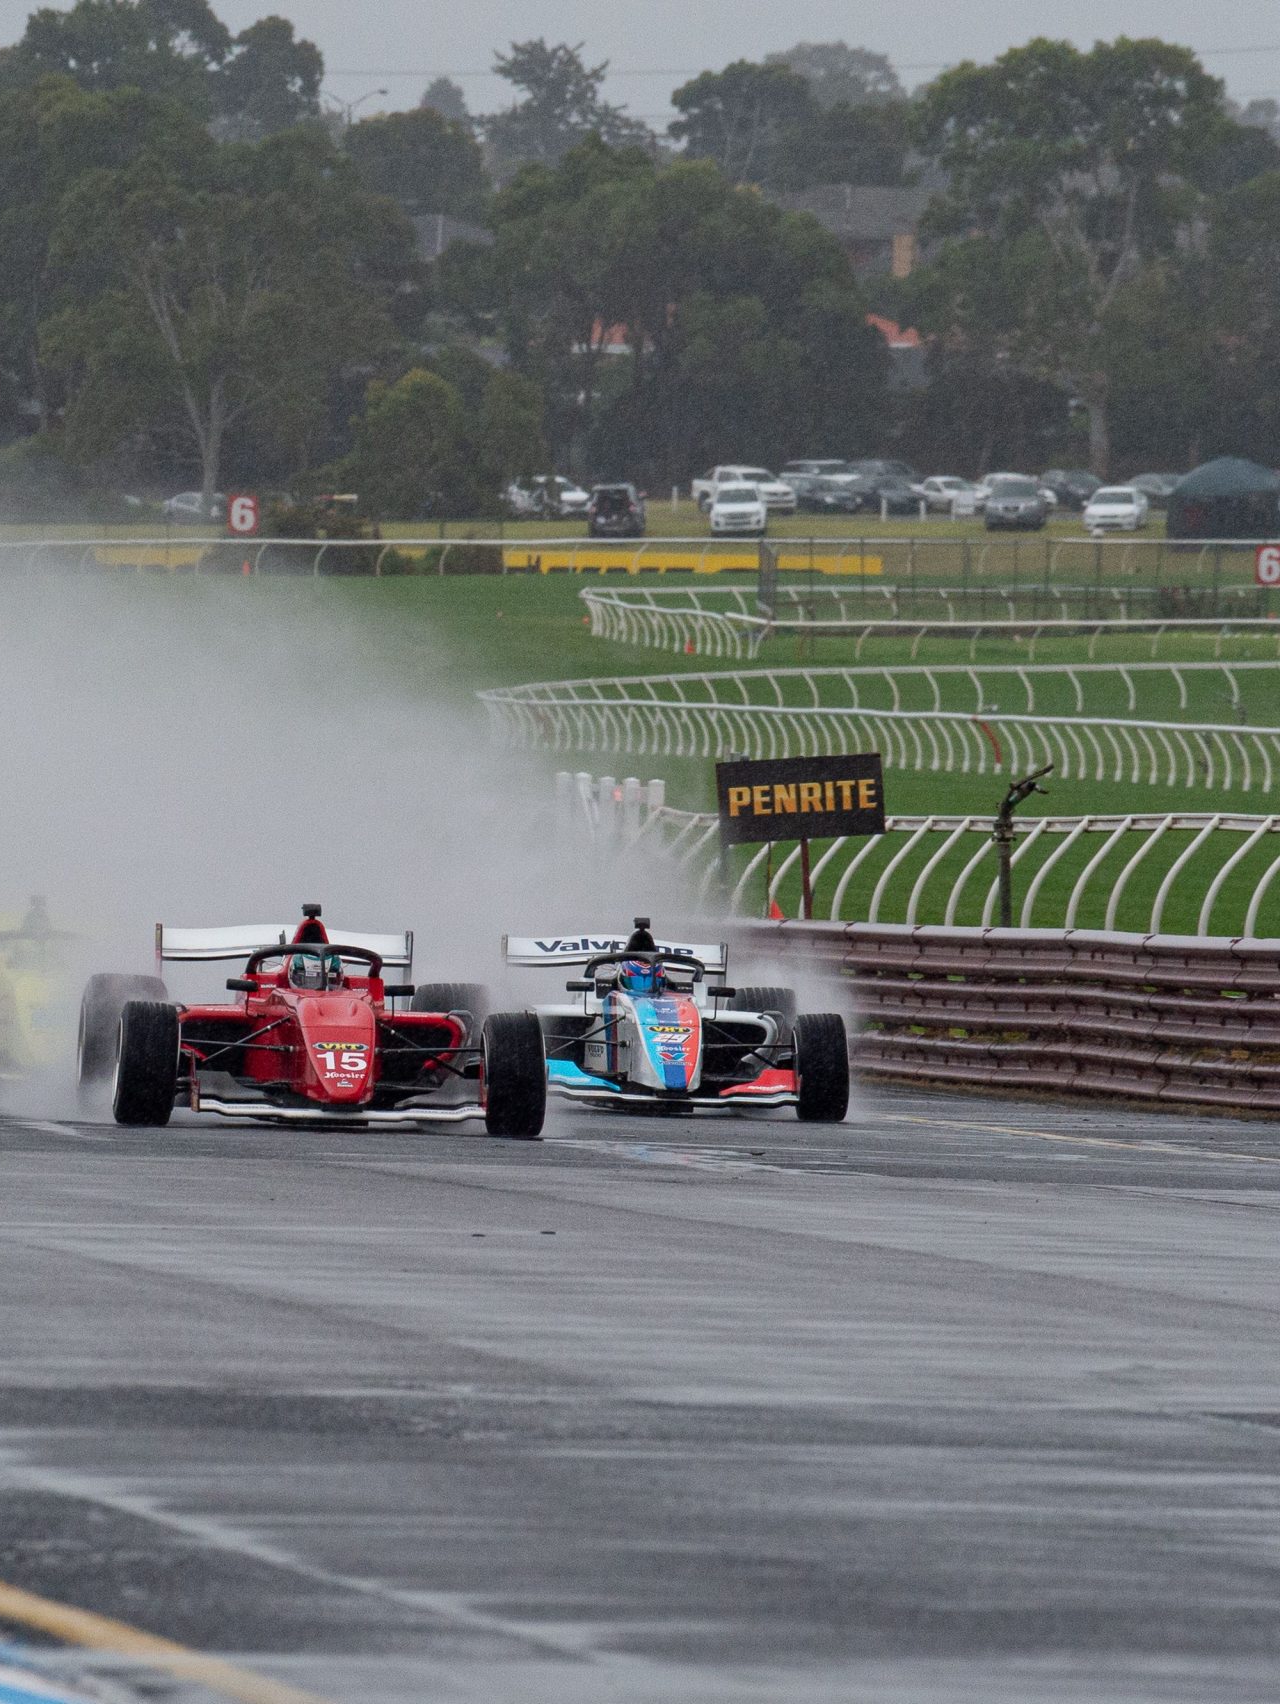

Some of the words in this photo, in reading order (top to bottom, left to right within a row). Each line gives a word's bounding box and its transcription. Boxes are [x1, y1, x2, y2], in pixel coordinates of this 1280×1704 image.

[231, 497, 255, 530] 6
[1258, 547, 1280, 582] 6
[728, 778, 878, 817] PENRITE
[534, 938, 694, 958] Valvone
[316, 1051, 367, 1071] 15
[324, 1071, 366, 1079] Hoosier
